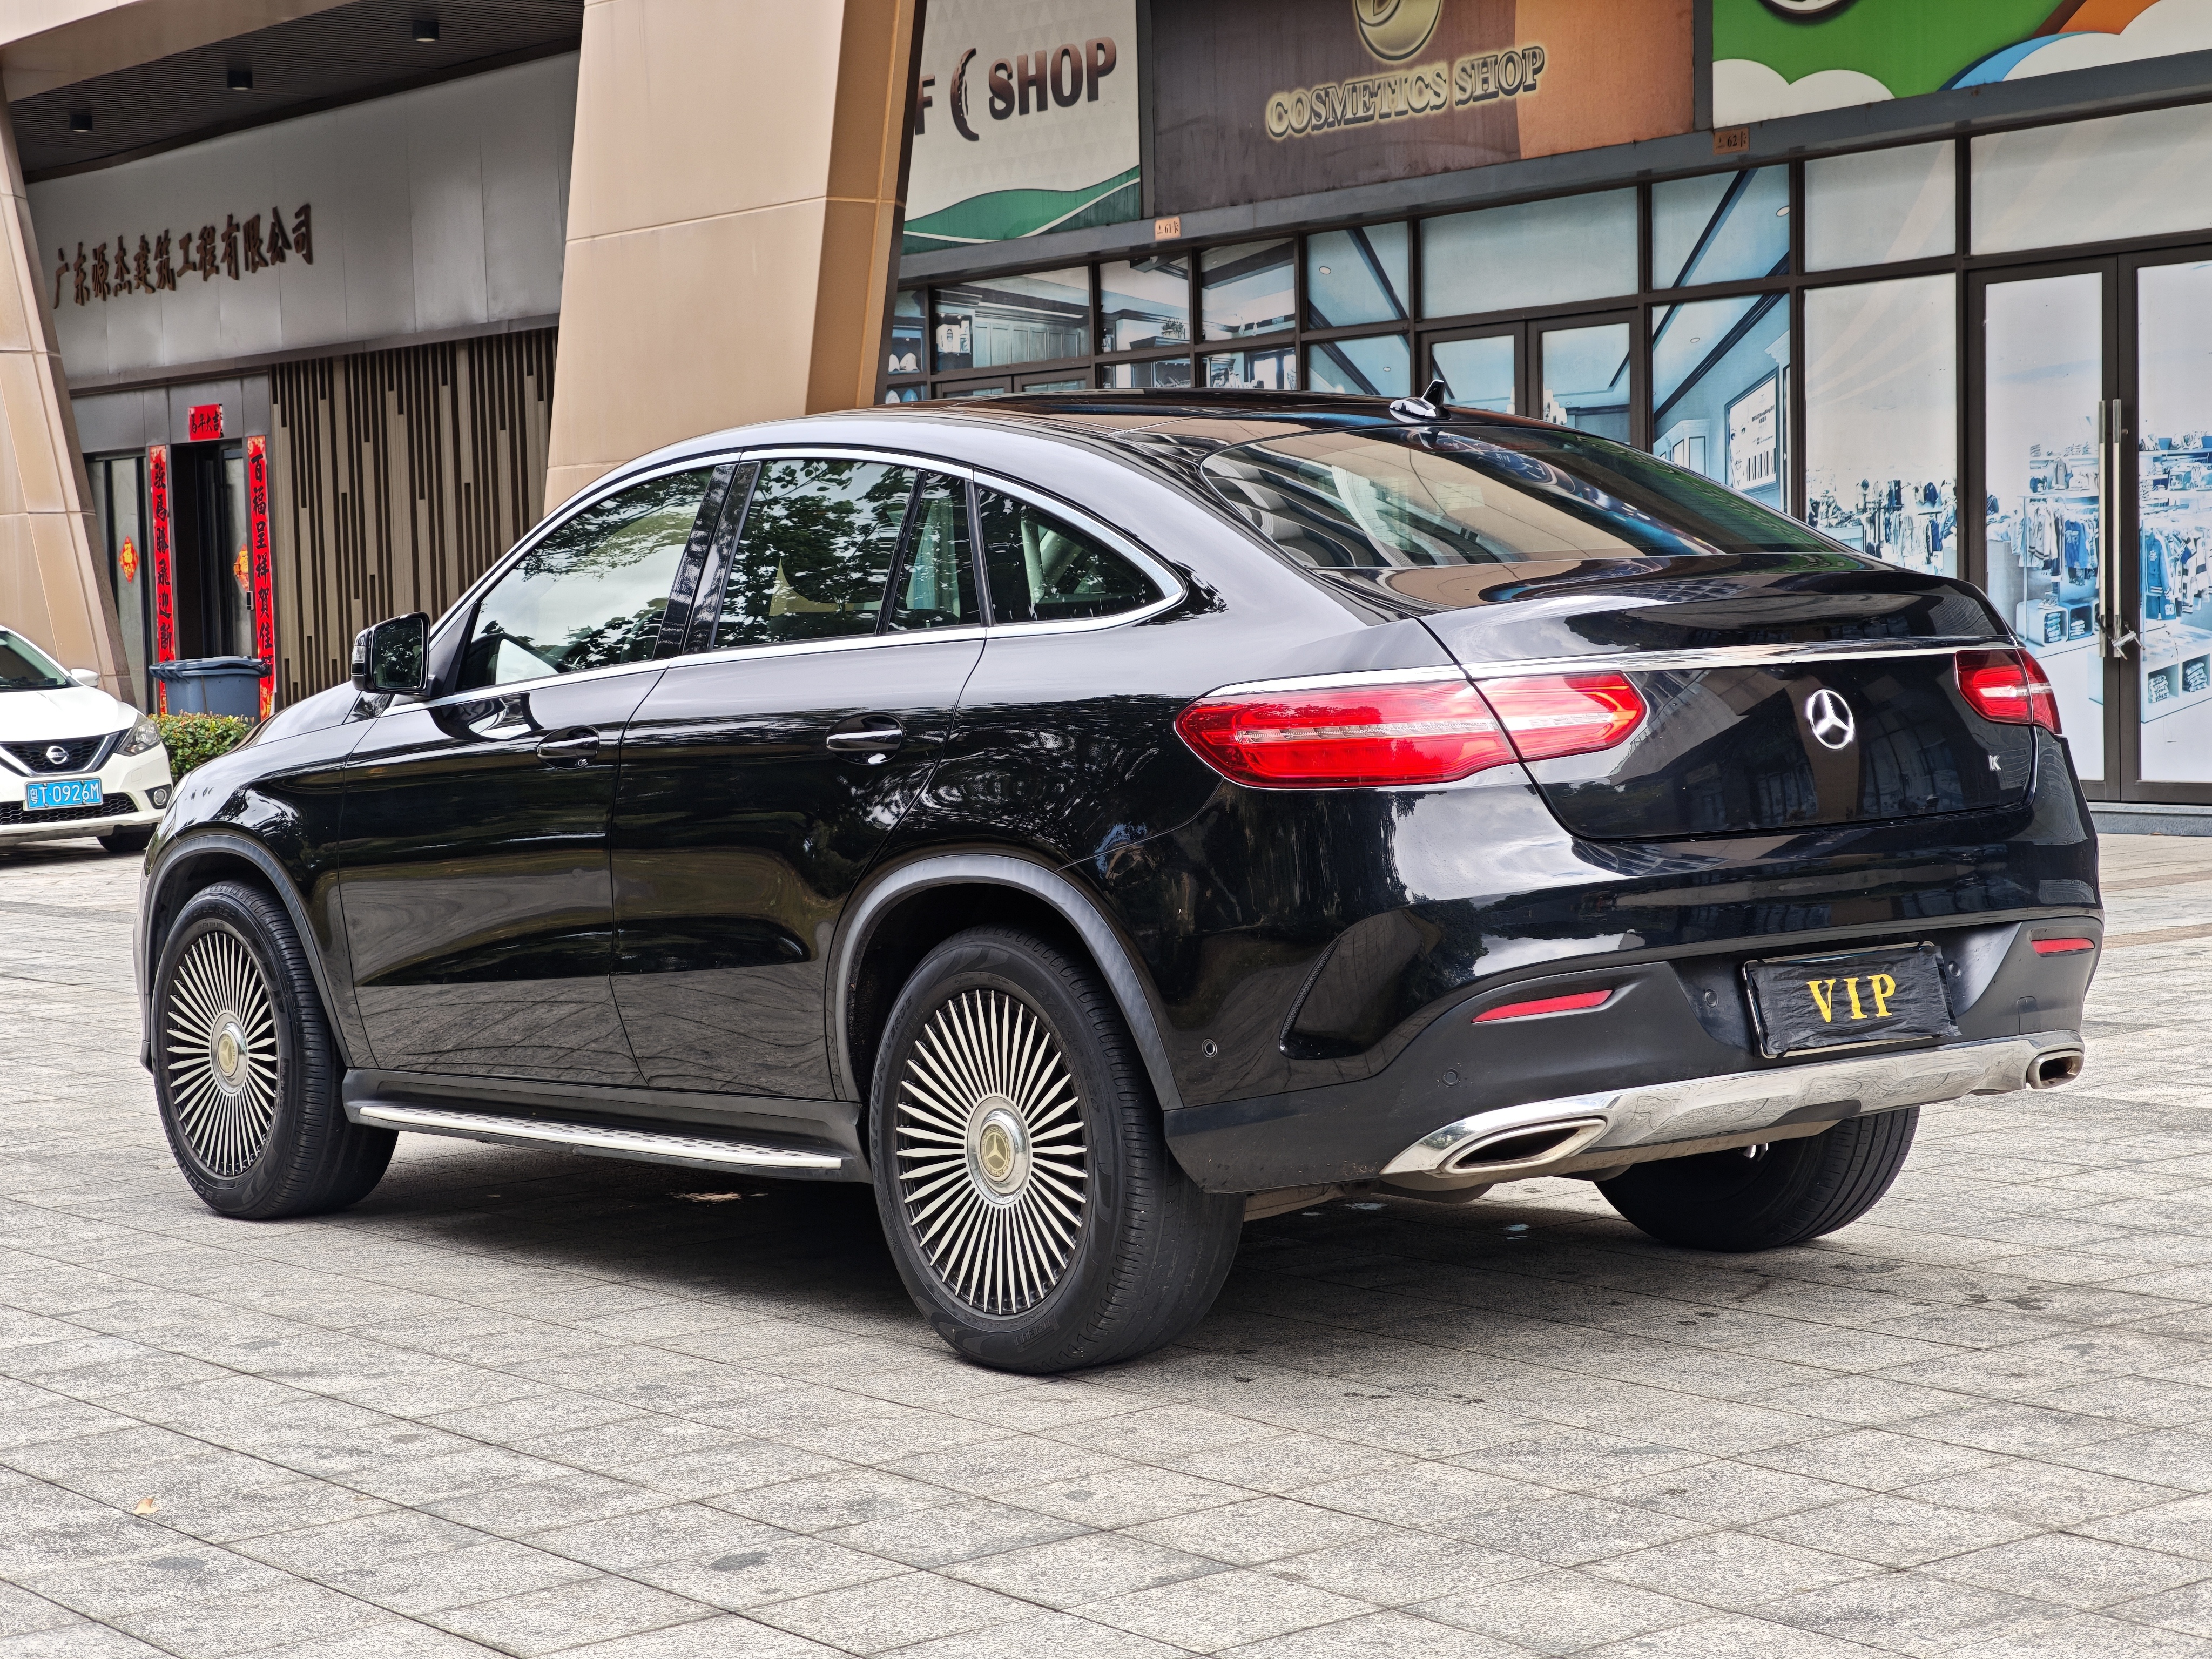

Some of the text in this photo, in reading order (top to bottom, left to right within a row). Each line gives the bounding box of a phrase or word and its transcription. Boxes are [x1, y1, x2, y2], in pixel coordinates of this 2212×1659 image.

[988, 36, 1117, 120] SHOP
[1267, 45, 1545, 138] COSMETICS SHOP
[53, 203, 314, 309] 广东源杰建筑工程有限公司
[1806, 974, 1896, 1023] VIP
